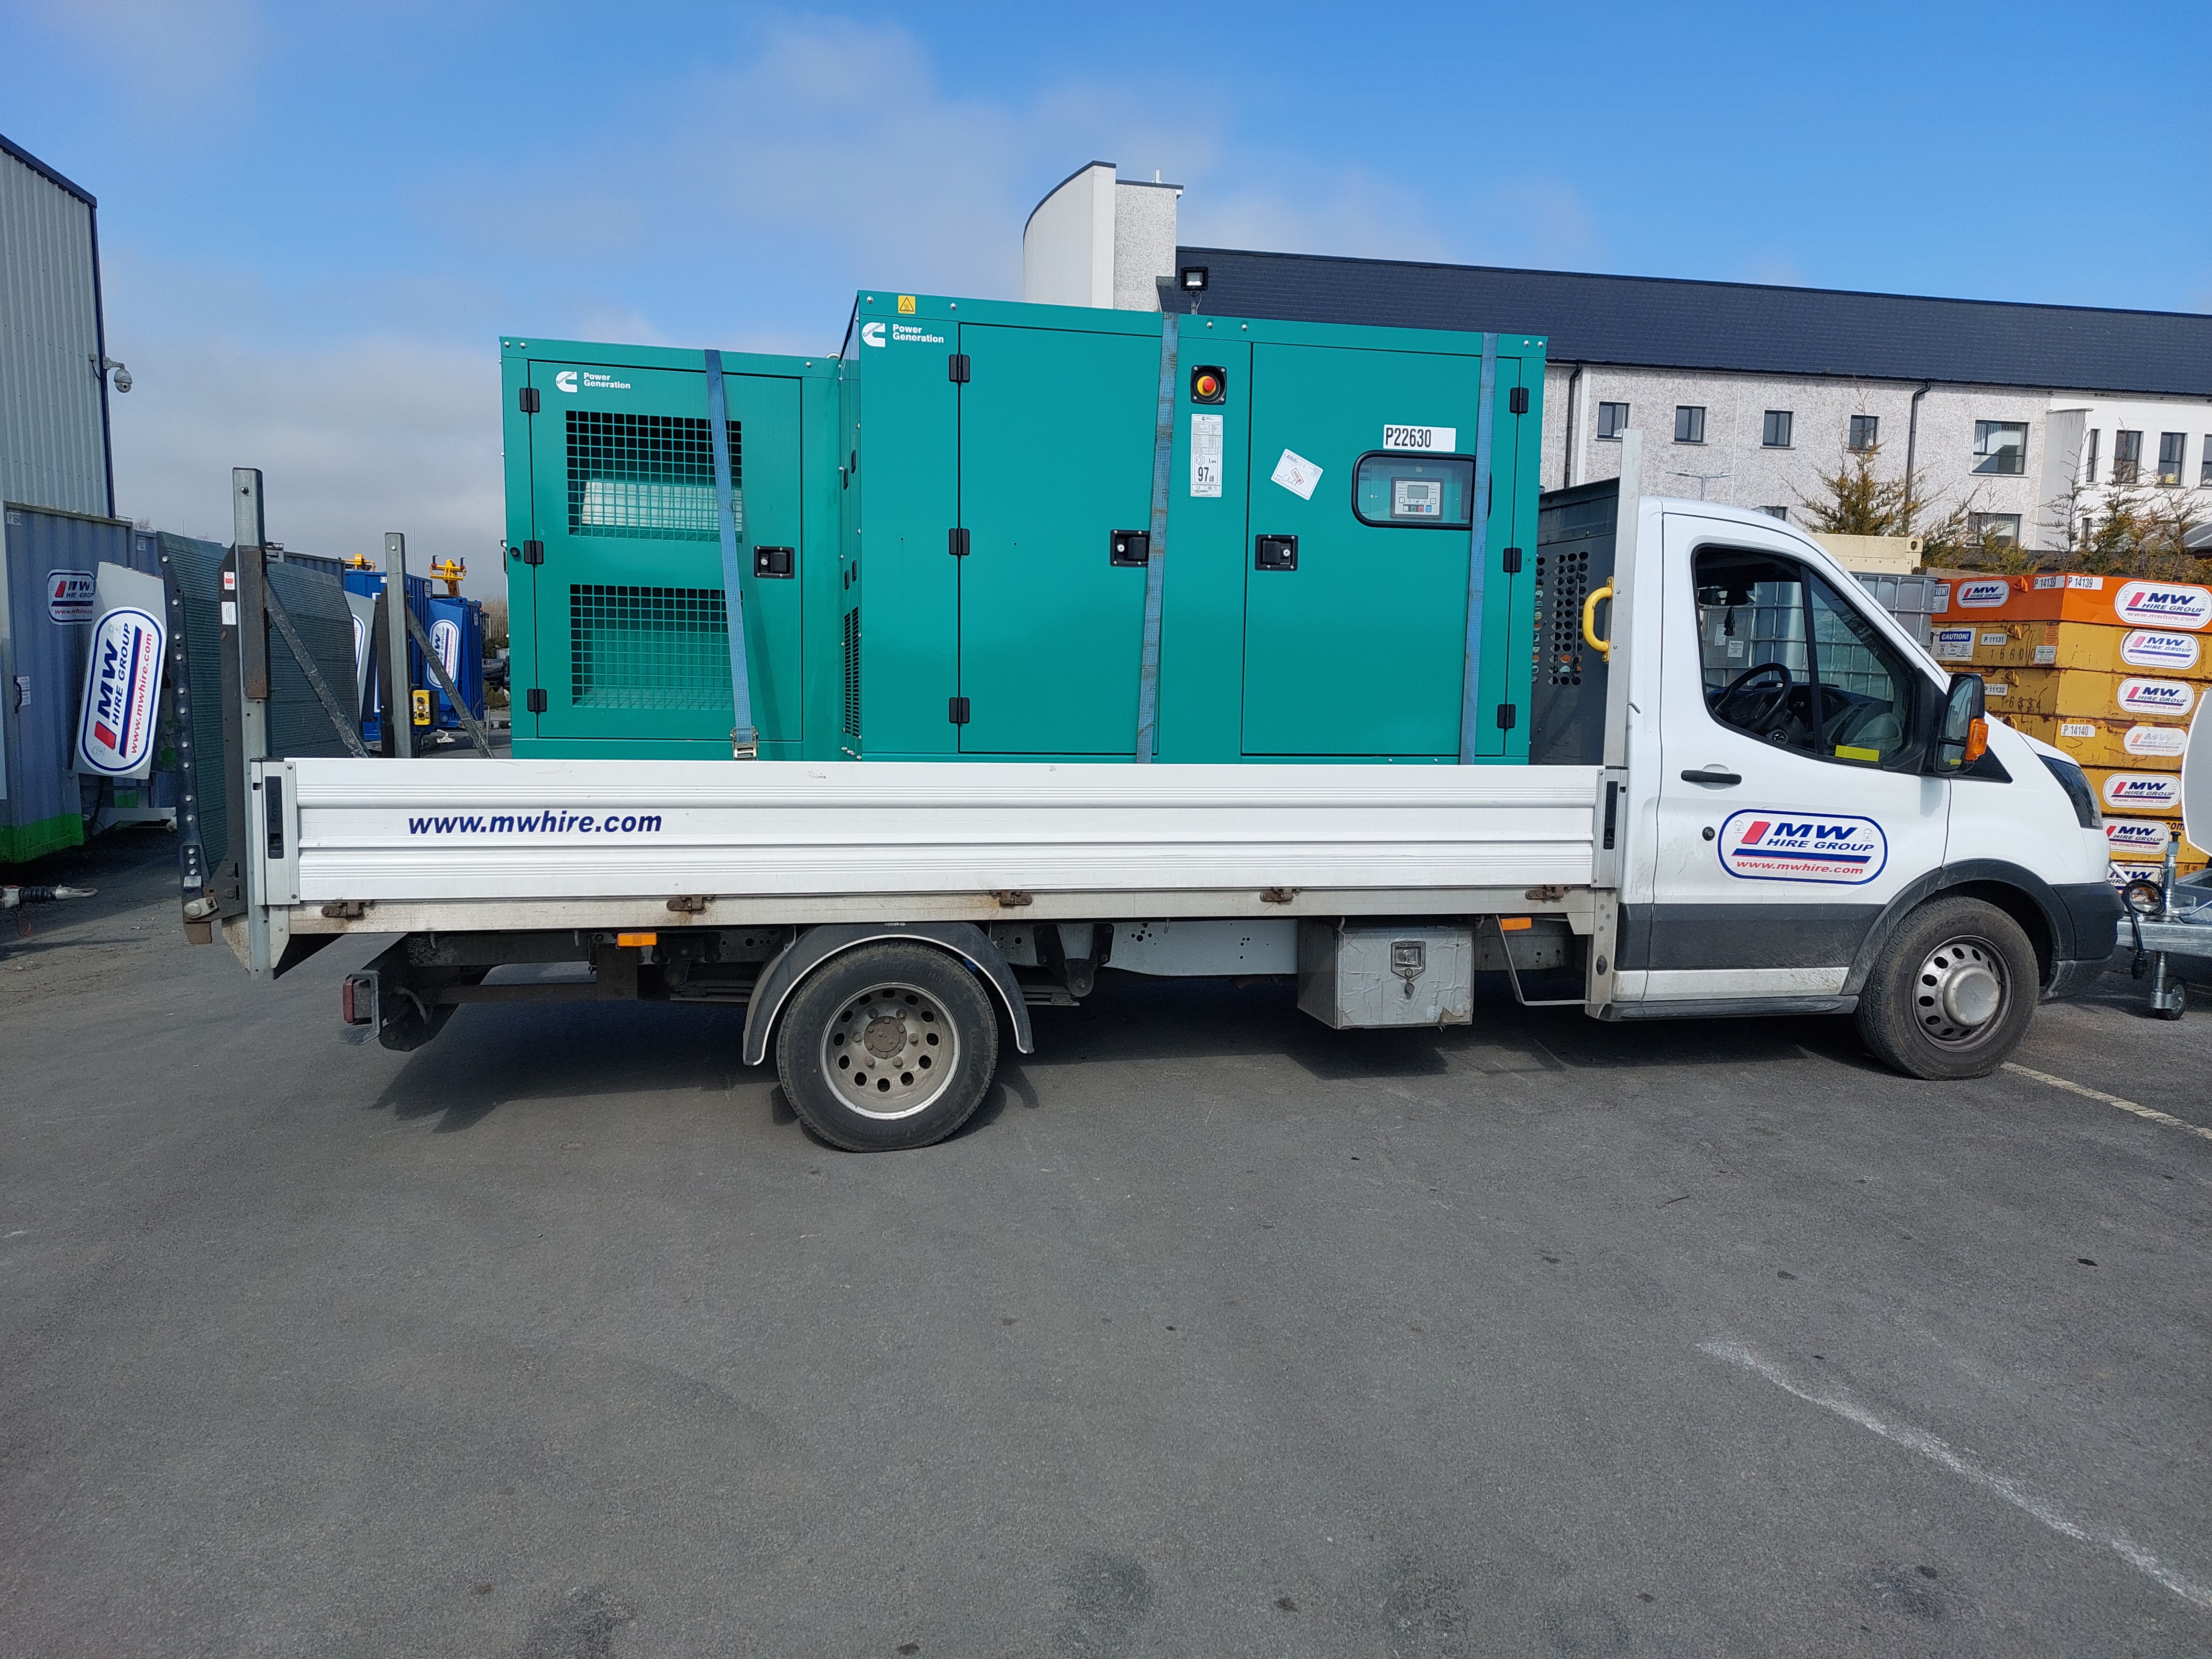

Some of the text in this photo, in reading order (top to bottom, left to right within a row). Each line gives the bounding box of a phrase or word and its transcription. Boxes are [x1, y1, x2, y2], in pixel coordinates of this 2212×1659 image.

[863, 323, 884, 337] Cummins
[893, 323, 922, 333] Power
[893, 332, 944, 343] Generation
[556, 372, 575, 384] Cummins
[584, 372, 610, 381] Power
[584, 379, 631, 389] Generation
[1385, 427, 1432, 448] P22630
[1198, 466, 1209, 482] 97
[2035, 577, 2057, 588] P 14139
[2068, 576, 2093, 588] P 14139
[2147, 592, 2196, 605] MW
[2127, 611, 2198, 622] www.mwhire.com
[2147, 637, 2186, 647] MW
[2129, 654, 2187, 664] www.mwhire.com
[97, 637, 118, 720] MW
[112, 622, 131, 726] HIRE GROUP
[131, 633, 153, 754] www.mwhire.com
[2142, 687, 2181, 697] MW
[2126, 702, 2181, 711] www.mwhire.com
[2063, 725, 2089, 736] P 14140
[2128, 782, 2169, 790] MW
[408, 810, 662, 835] www.mwhire.com
[1773, 822, 1858, 840] MW
[2117, 826, 2158, 836] MW
[1766, 838, 1874, 852] HIRE GROUP
[1736, 861, 1863, 874] www.mwhire.com
